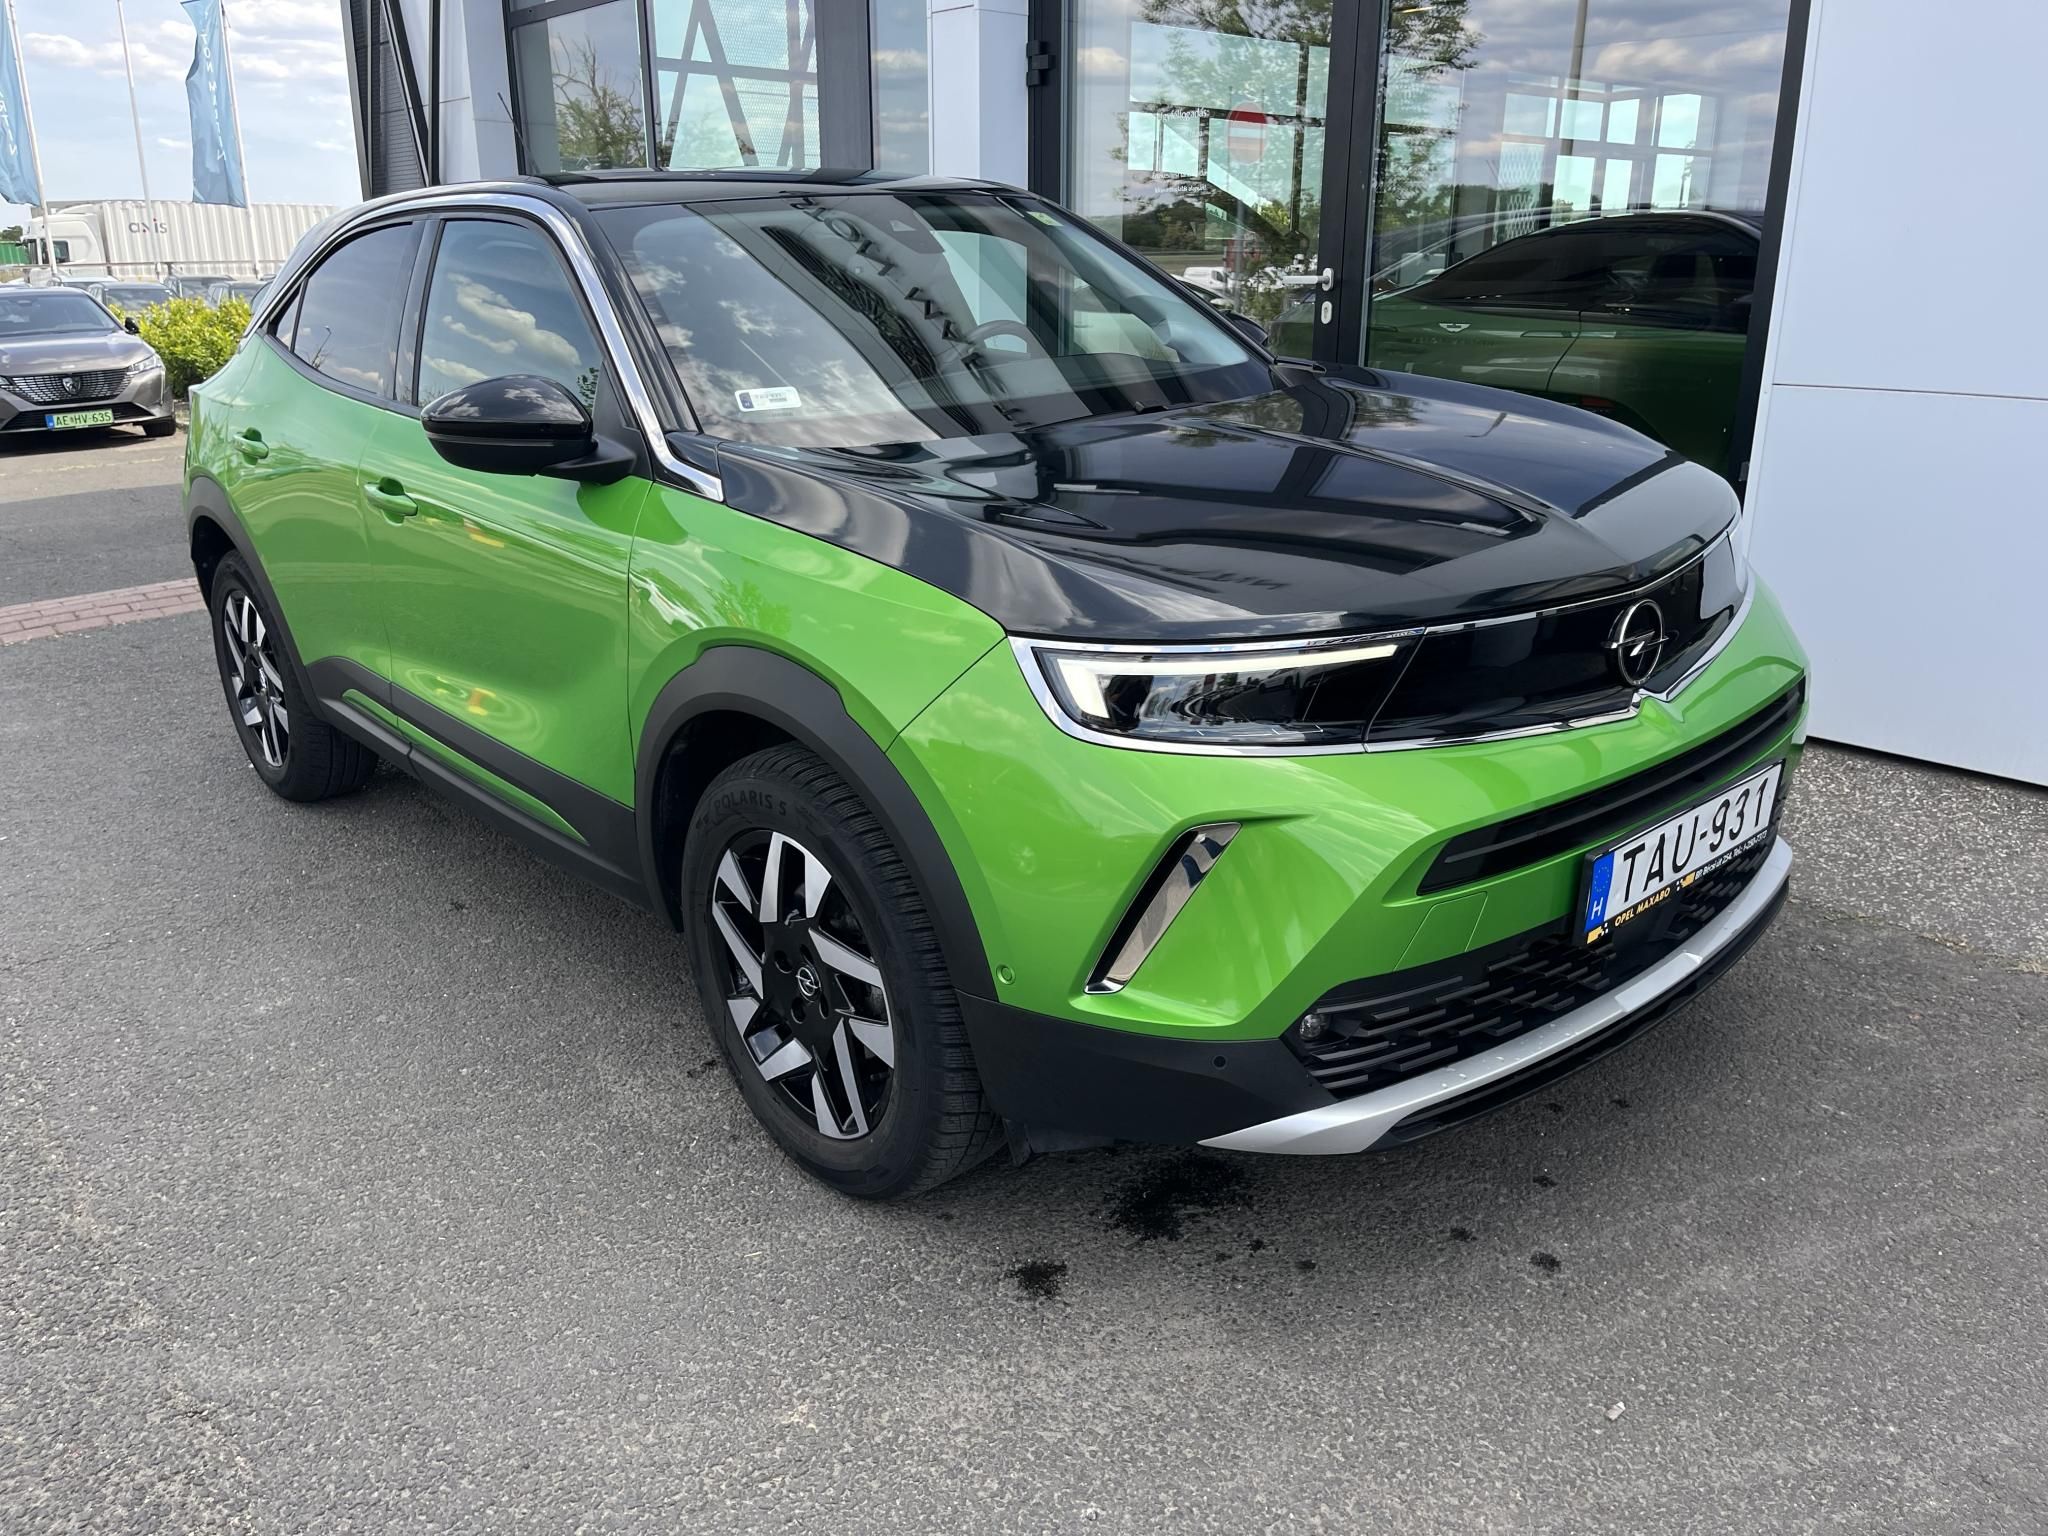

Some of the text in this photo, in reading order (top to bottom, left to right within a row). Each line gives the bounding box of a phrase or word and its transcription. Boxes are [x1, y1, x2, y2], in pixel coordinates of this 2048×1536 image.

[713, 789, 774, 816] POLARIS
[1623, 777, 1769, 903] TAU-931
[1591, 896, 1604, 921] H
[1614, 887, 1671, 927] OPEL MAXABO
